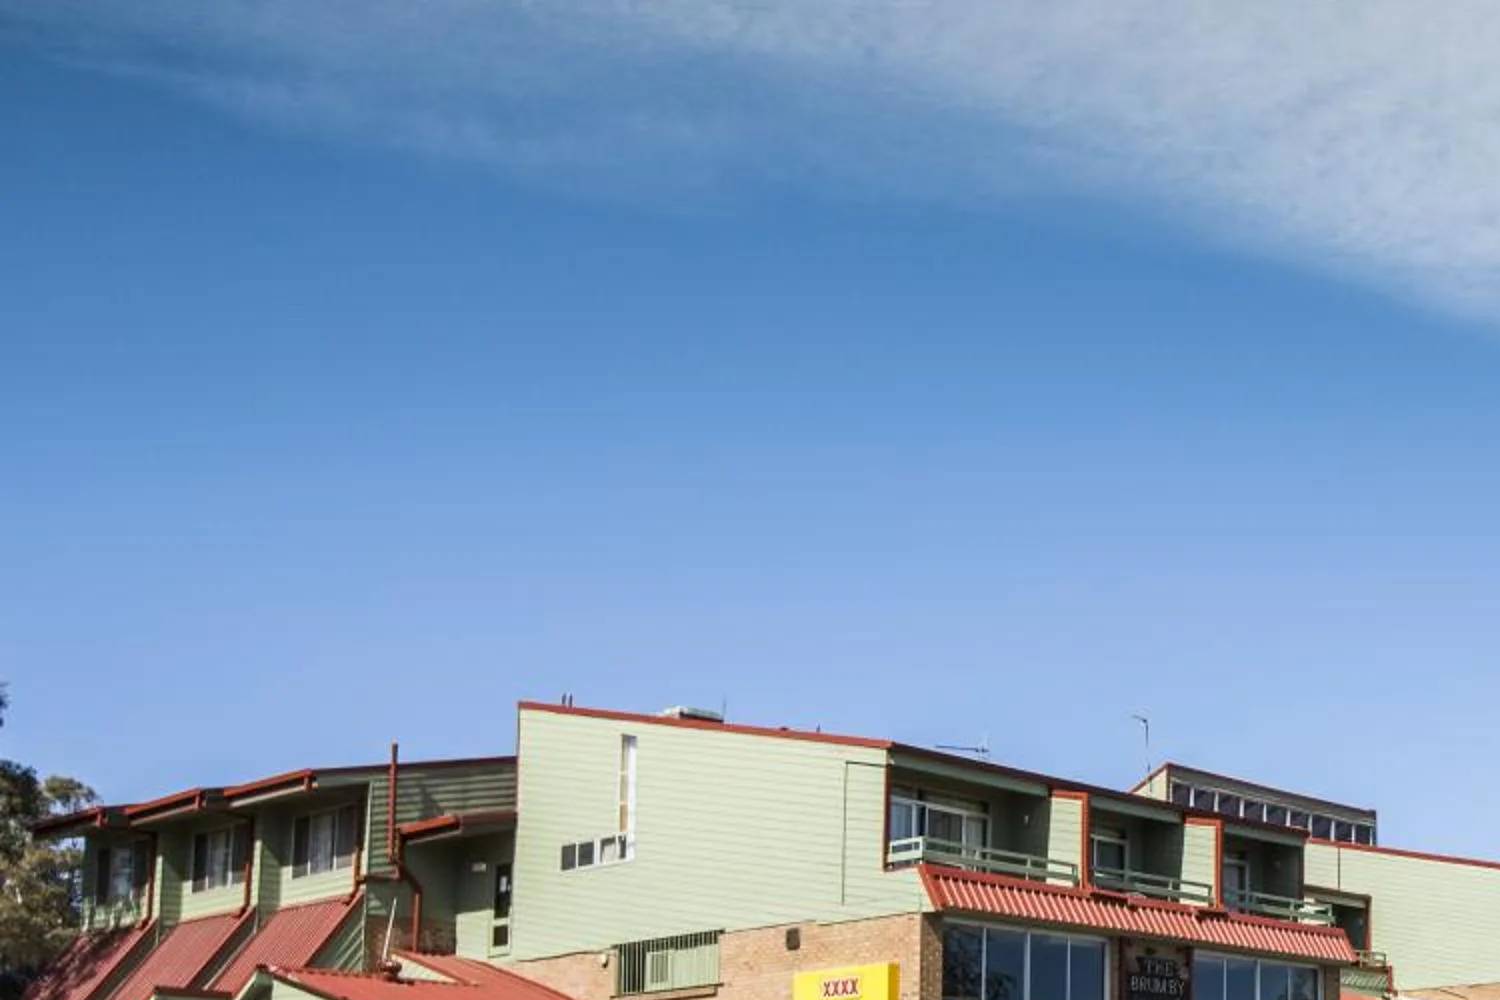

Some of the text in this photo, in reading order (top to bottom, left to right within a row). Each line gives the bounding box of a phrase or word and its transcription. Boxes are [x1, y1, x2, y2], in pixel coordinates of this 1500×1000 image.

[1143, 959, 1175, 977] THE
[823, 978, 858, 997] XXXX
[1131, 975, 1185, 996] BRUMBY
